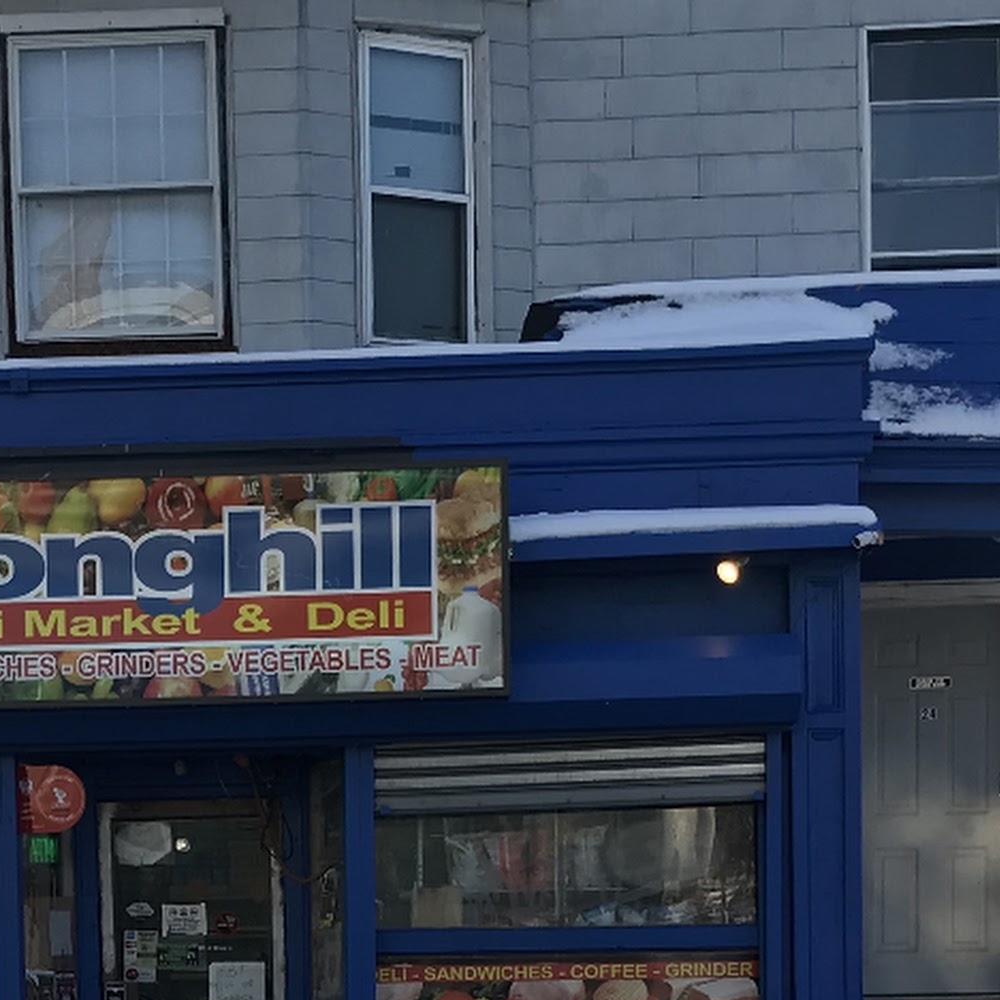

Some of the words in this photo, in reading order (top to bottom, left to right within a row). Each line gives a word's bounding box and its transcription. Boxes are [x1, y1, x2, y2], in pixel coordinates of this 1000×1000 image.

[24, 607, 201, 638] Market
[233, 604, 272, 633] &
[307, 600, 405, 631] Deli
[78, 652, 206, 677] GRINDERS
[227, 647, 391, 675] VEGETABLES
[414, 644, 481, 669] MEAT
[376, 968, 408, 982] ELI
[424, 965, 553, 981] SANDWICHES
[570, 963, 647, 979] COFFEE
[665, 962, 753, 977] GRINDER
